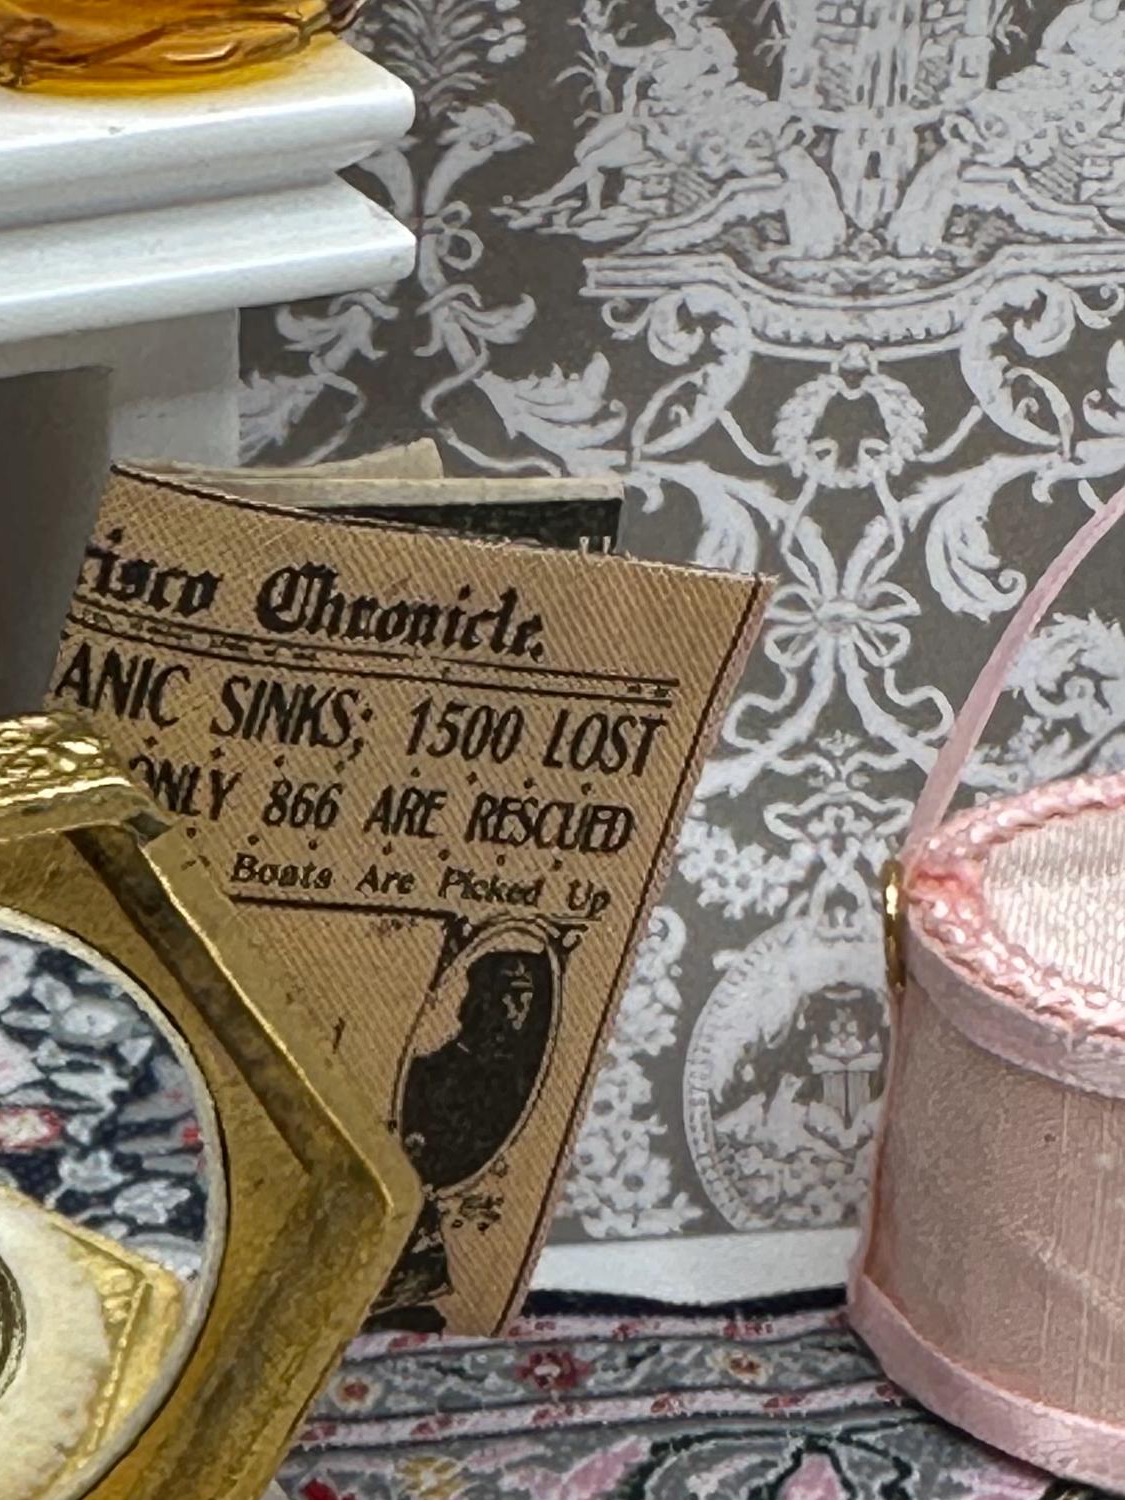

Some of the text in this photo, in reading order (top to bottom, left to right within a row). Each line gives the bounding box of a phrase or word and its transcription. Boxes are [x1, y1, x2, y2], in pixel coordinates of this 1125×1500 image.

[78, 527, 223, 618] isco
[54, 630, 192, 730] ANIC
[406, 700, 526, 764] 1500
[542, 709, 668, 777] LOST
[262, 780, 343, 829] 866
[364, 784, 448, 839] ARE
[465, 792, 636, 854] RESCUED
[230, 852, 613, 920] Boats Are Picked Up
